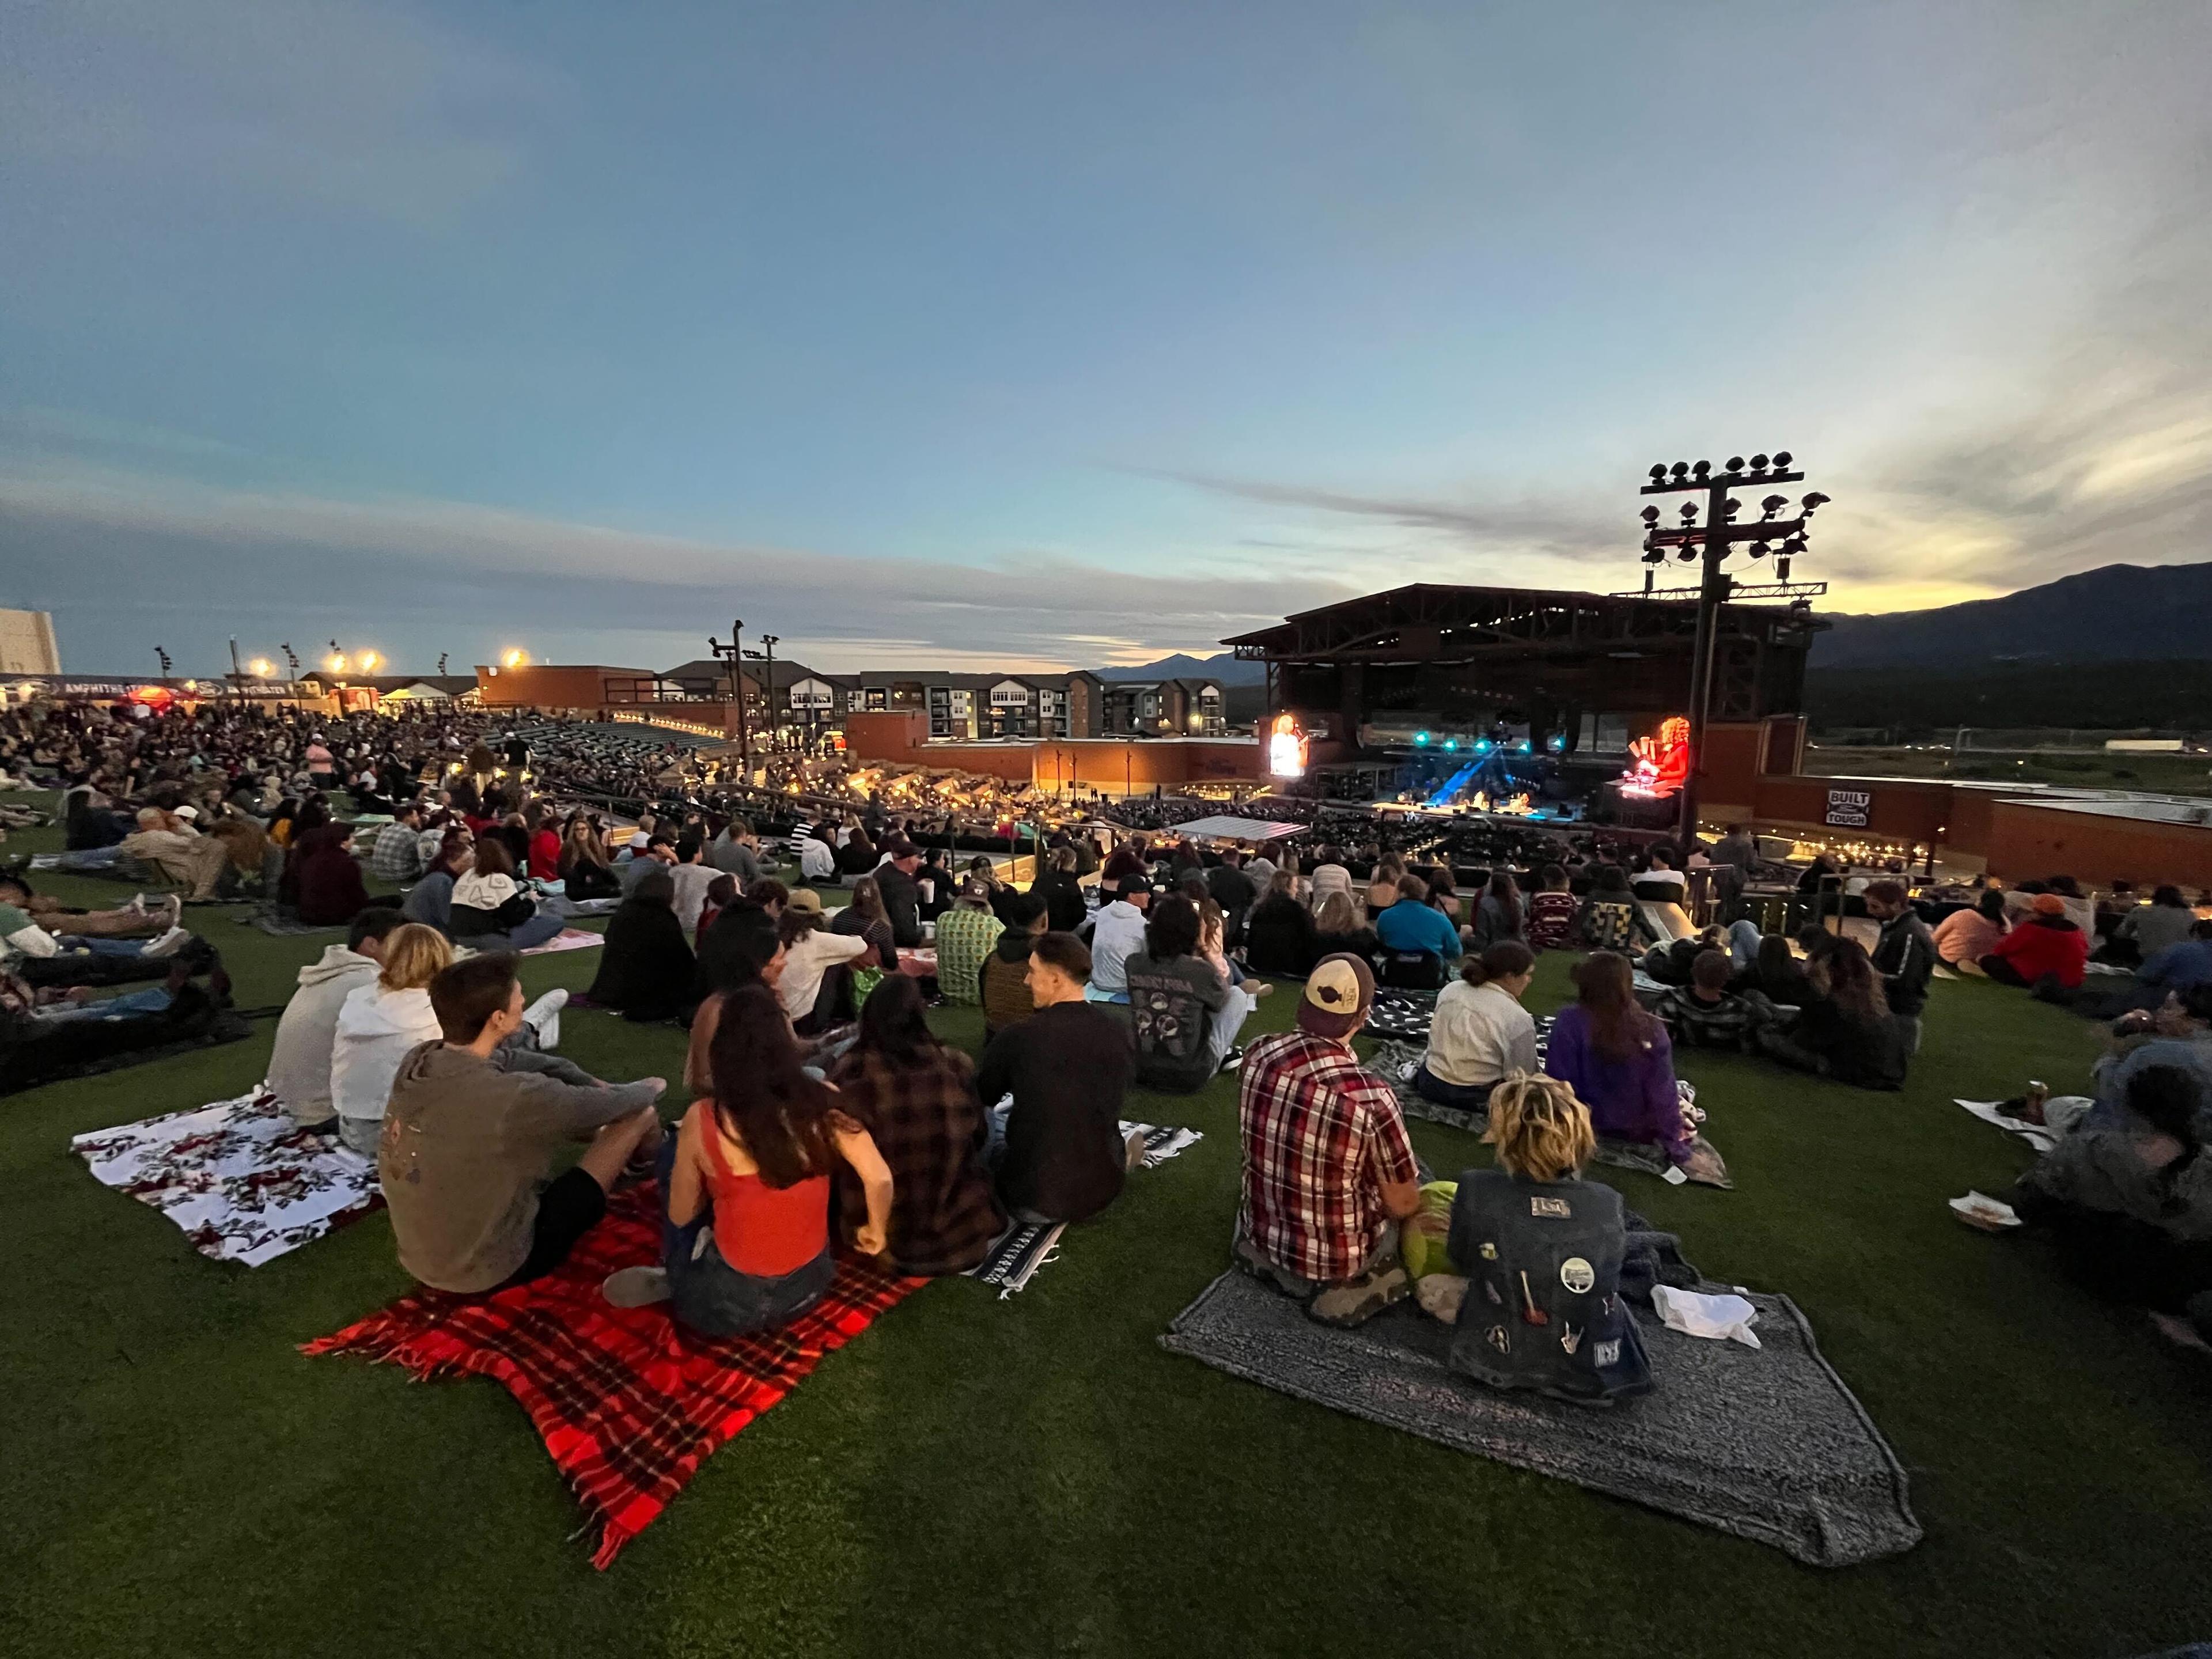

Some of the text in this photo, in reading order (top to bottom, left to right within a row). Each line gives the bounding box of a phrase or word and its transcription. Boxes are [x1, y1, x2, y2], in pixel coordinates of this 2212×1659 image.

[66, 684, 141, 693] AMPHITHEAT
[228, 686, 286, 694] AMHITHEATER
[1831, 792, 1868, 804] BUILT
[1828, 815, 1865, 824] TOUGH
